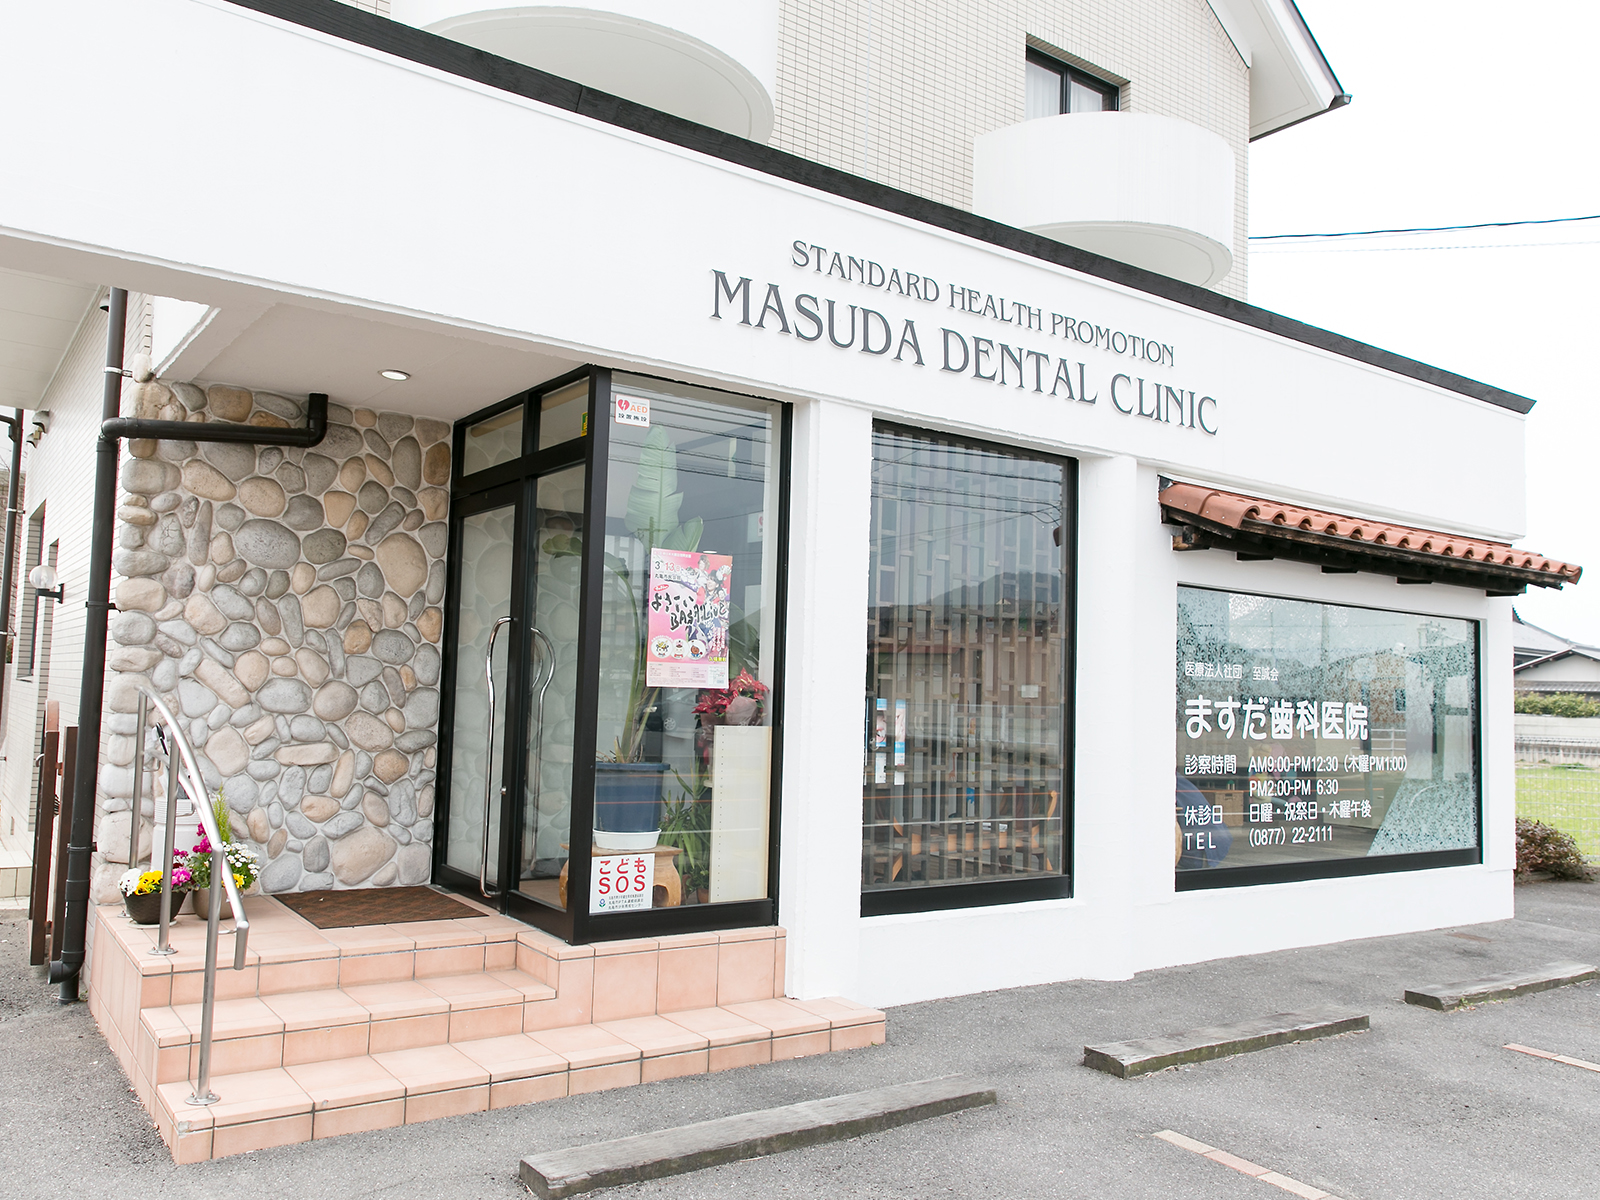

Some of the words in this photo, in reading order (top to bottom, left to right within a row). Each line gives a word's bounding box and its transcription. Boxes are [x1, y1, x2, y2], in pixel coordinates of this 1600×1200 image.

[791, 239, 940, 303] STANDARD
[949, 283, 1043, 332] HEALTH
[1051, 313, 1175, 367] PROMOTION
[709, 268, 926, 368] MASUDA
[939, 327, 1098, 405] DENTAL
[1110, 372, 1219, 436] CLINIC
[630, 405, 647, 413] AED
[1185, 661, 1243, 680] 医療法人社団
[1185, 695, 1368, 740] ますだ歯科医院
[1185, 754, 1237, 775] 診察時間
[1185, 805, 1223, 826] 休診日
[1185, 832, 1217, 850] TEL
[1249, 828, 1286, 847] (0877)
[1292, 826, 1333, 844] 22-2111
[599, 857, 646, 874] こども
[598, 875, 645, 894] SOS
